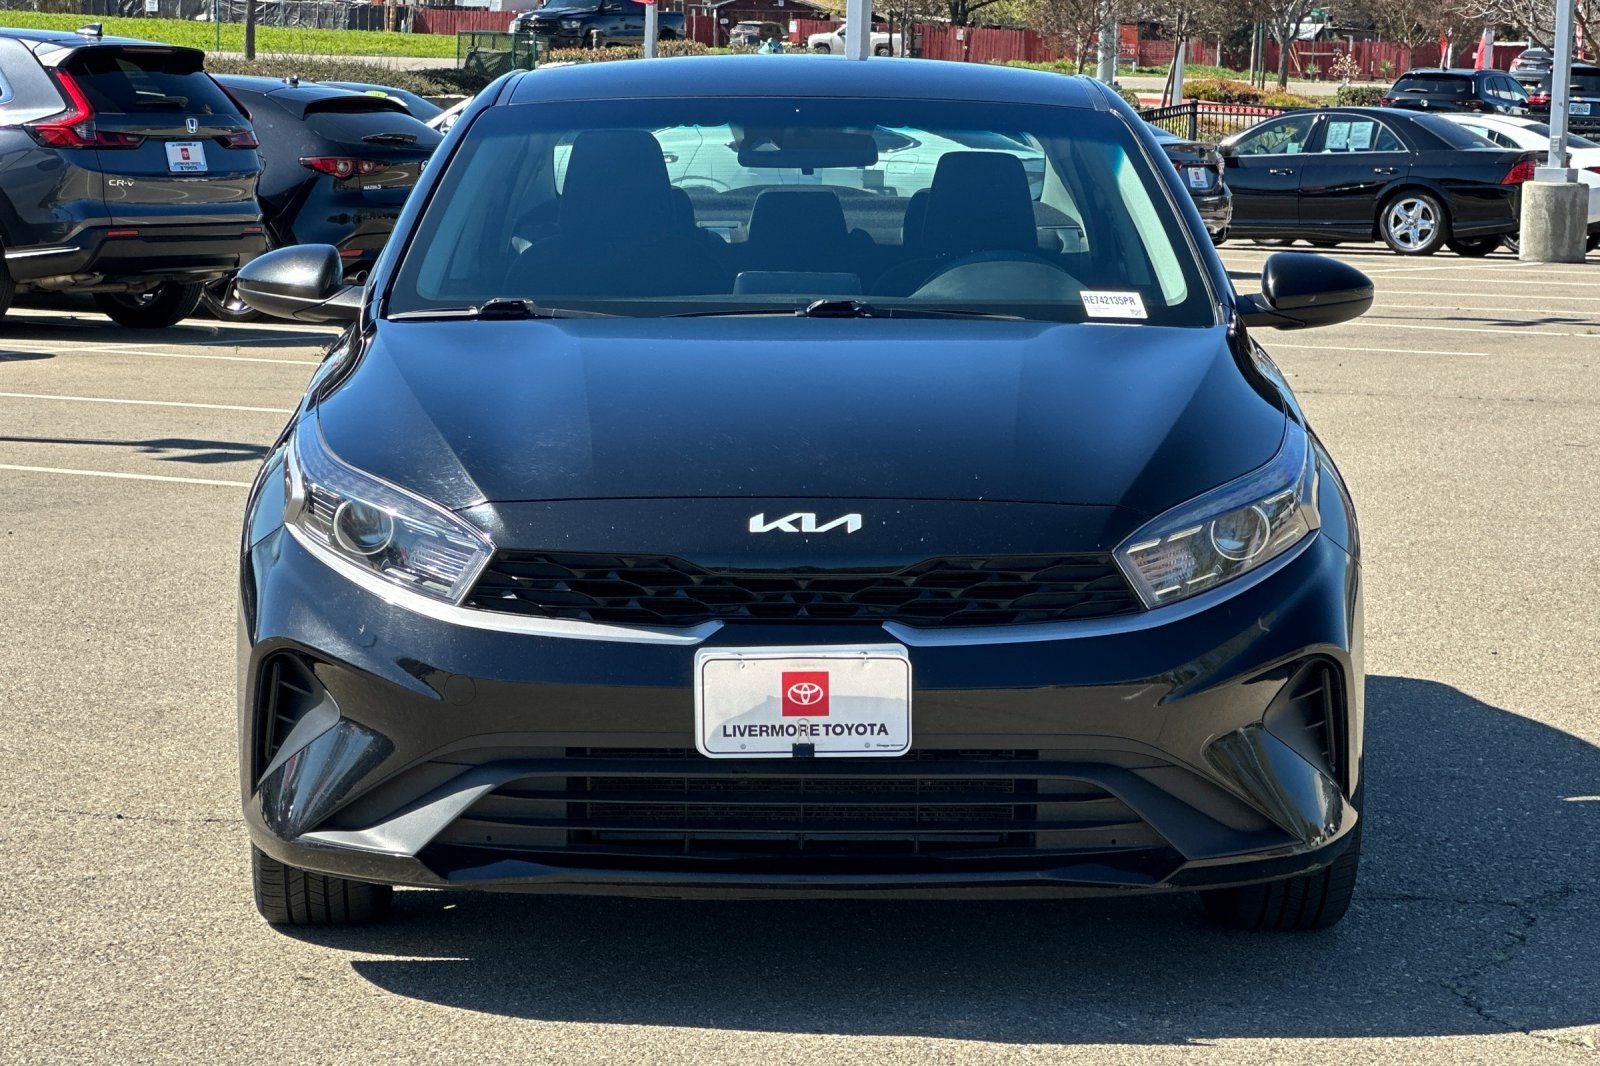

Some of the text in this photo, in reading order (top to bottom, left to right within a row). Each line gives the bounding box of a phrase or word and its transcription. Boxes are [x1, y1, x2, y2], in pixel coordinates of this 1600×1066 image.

[749, 513, 862, 533] KIA
[724, 723, 887, 737] LIVERMORE TOYOTA
